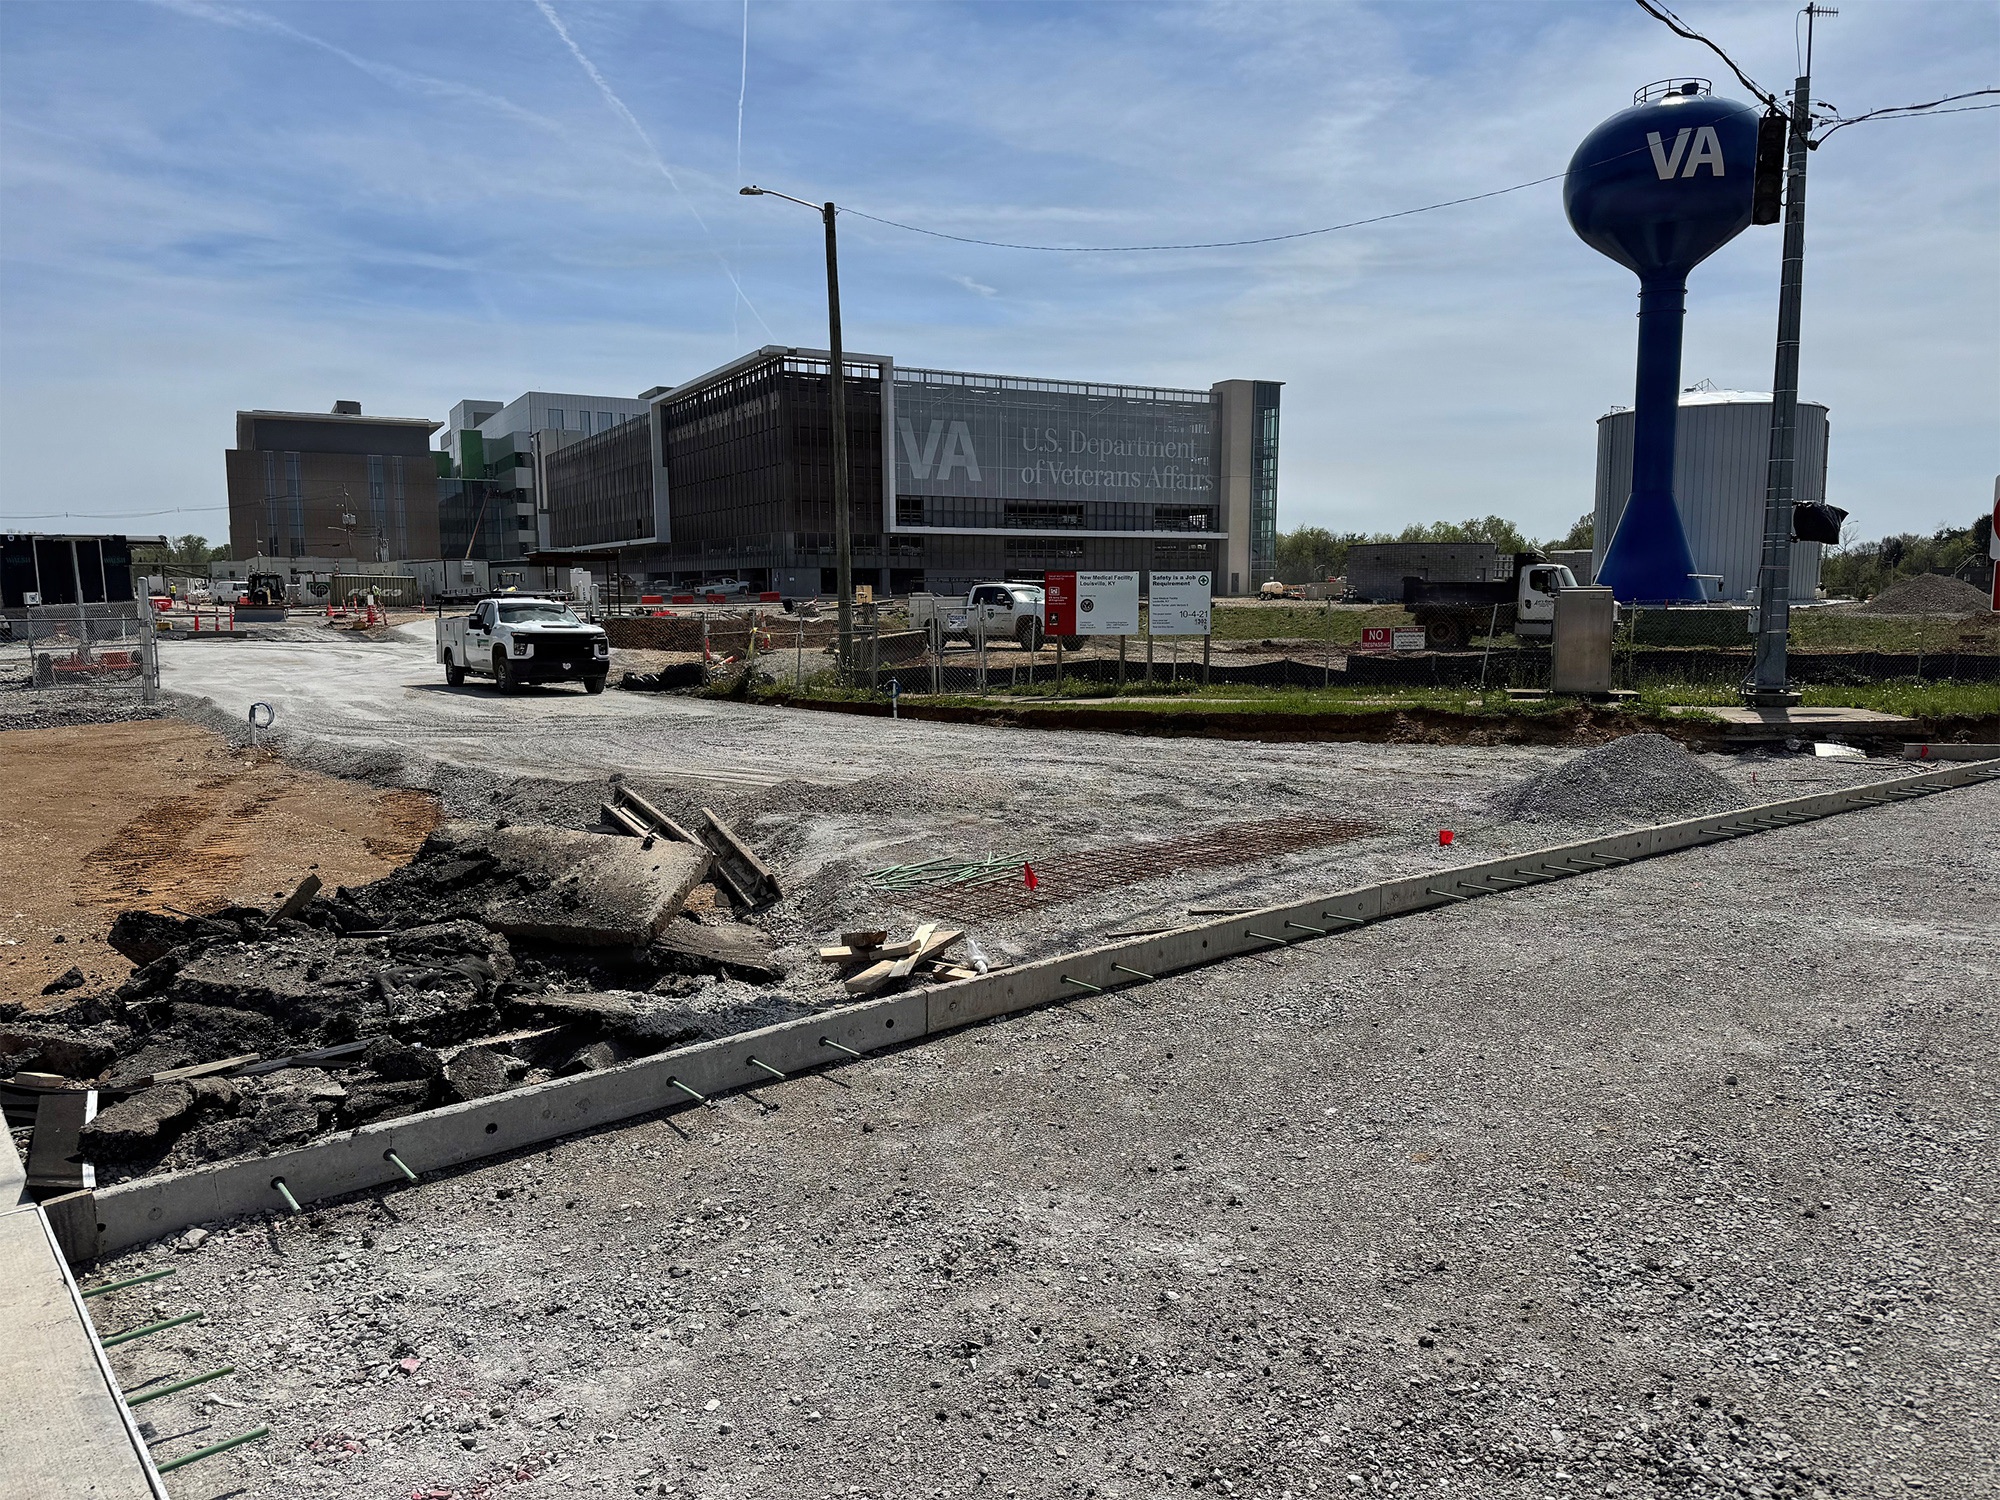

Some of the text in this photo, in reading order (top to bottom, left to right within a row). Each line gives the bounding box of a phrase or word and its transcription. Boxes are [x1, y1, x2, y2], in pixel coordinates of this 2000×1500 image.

[1646, 126, 1725, 180] VA
[897, 416, 982, 482] VA
[1021, 426, 1197, 463] U.S. Department
[1021, 459, 1215, 491] of Veterans Affairs
[1180, 610, 1208, 618] 10-4-21
[1369, 629, 1384, 641] NO
